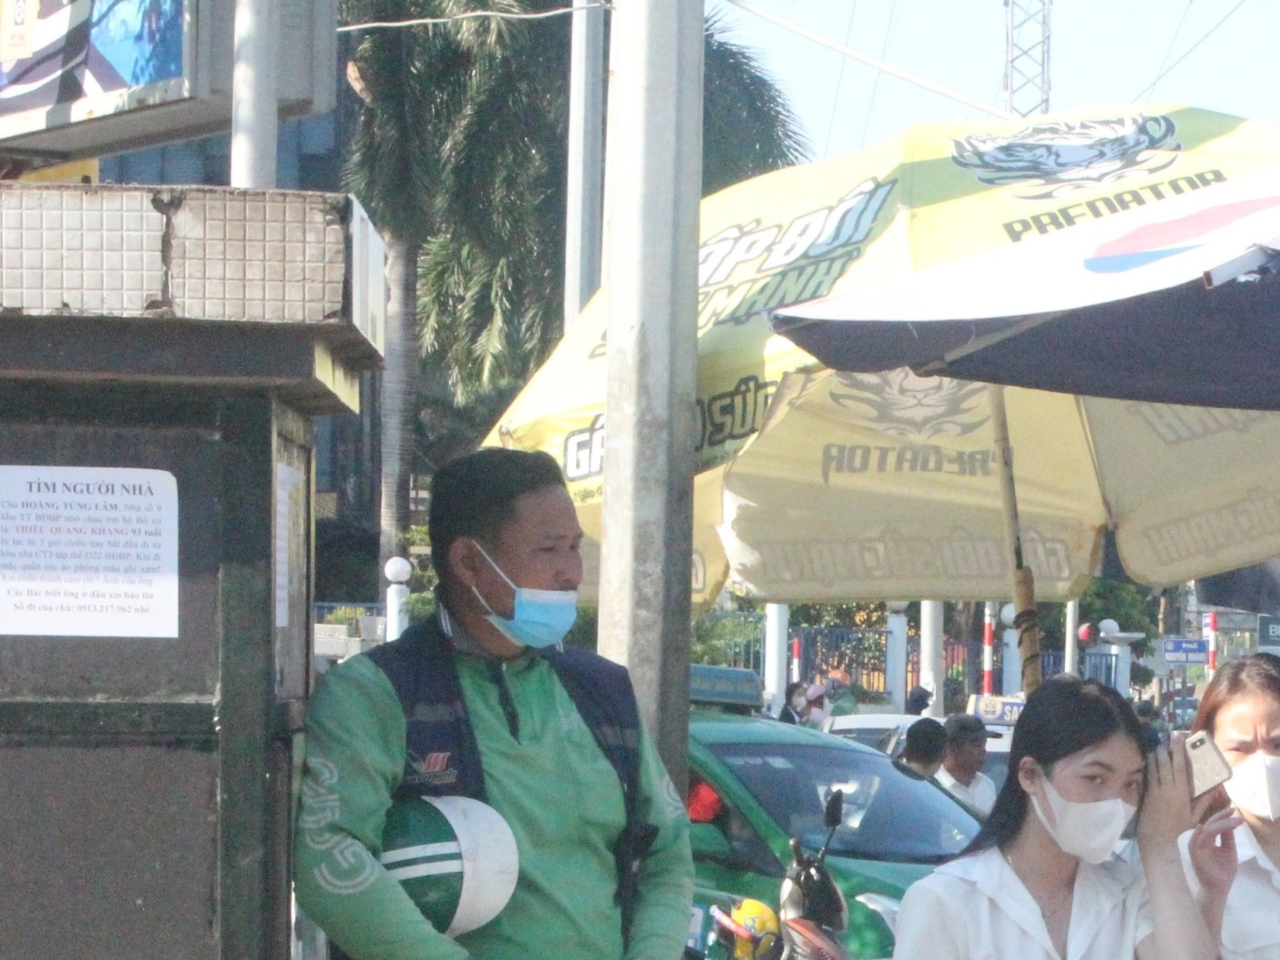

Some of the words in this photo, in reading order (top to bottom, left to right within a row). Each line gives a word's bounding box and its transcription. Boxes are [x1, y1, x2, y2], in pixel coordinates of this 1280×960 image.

[699, 218, 782, 288] ẤP
[26, 478, 56, 494] TÌM
[62, 480, 114, 496] NGƯỜI
[120, 480, 154, 496] NHÀ
